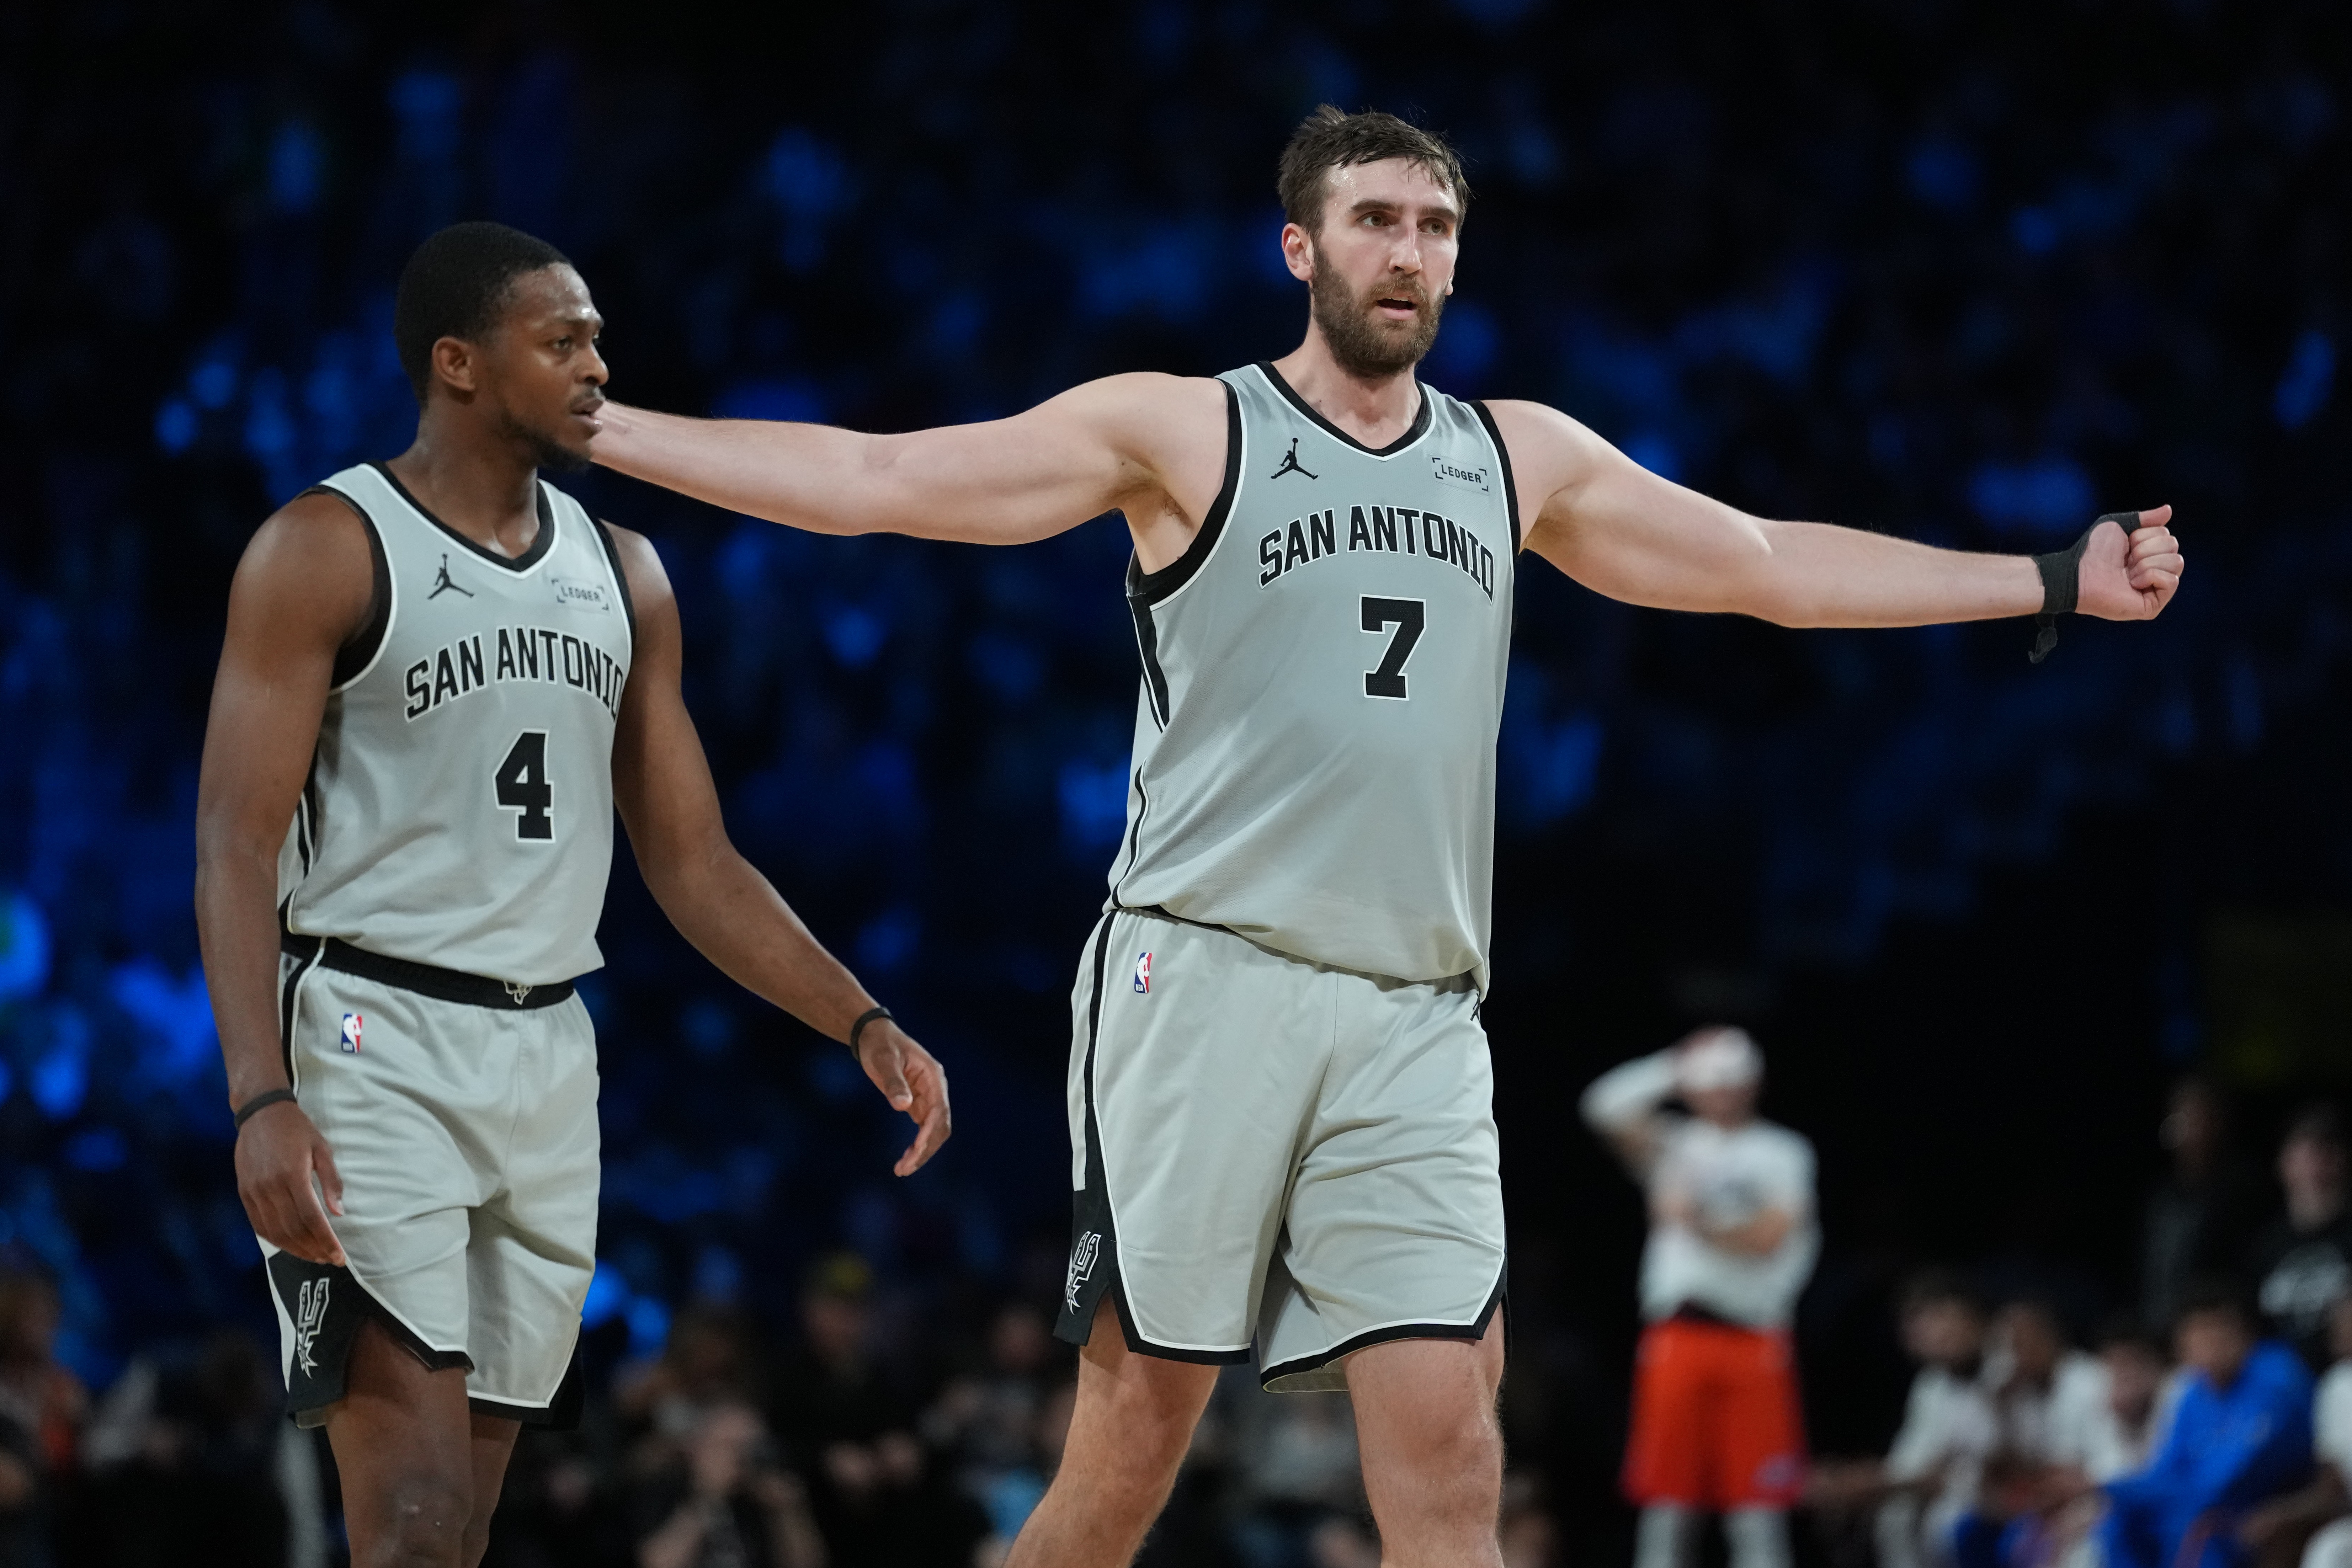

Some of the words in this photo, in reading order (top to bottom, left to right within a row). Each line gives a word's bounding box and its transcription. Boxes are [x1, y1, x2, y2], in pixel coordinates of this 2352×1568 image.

[1441, 464, 1481, 484] LEDGER
[560, 586, 601, 602] LEDGER
[1258, 507, 1337, 589] SAN
[1347, 504, 1494, 606] ANTONIO
[404, 631, 487, 722] SAN
[495, 624, 623, 723] ANTONIO
[1359, 593, 1427, 701] 7
[492, 729, 555, 843] 4
